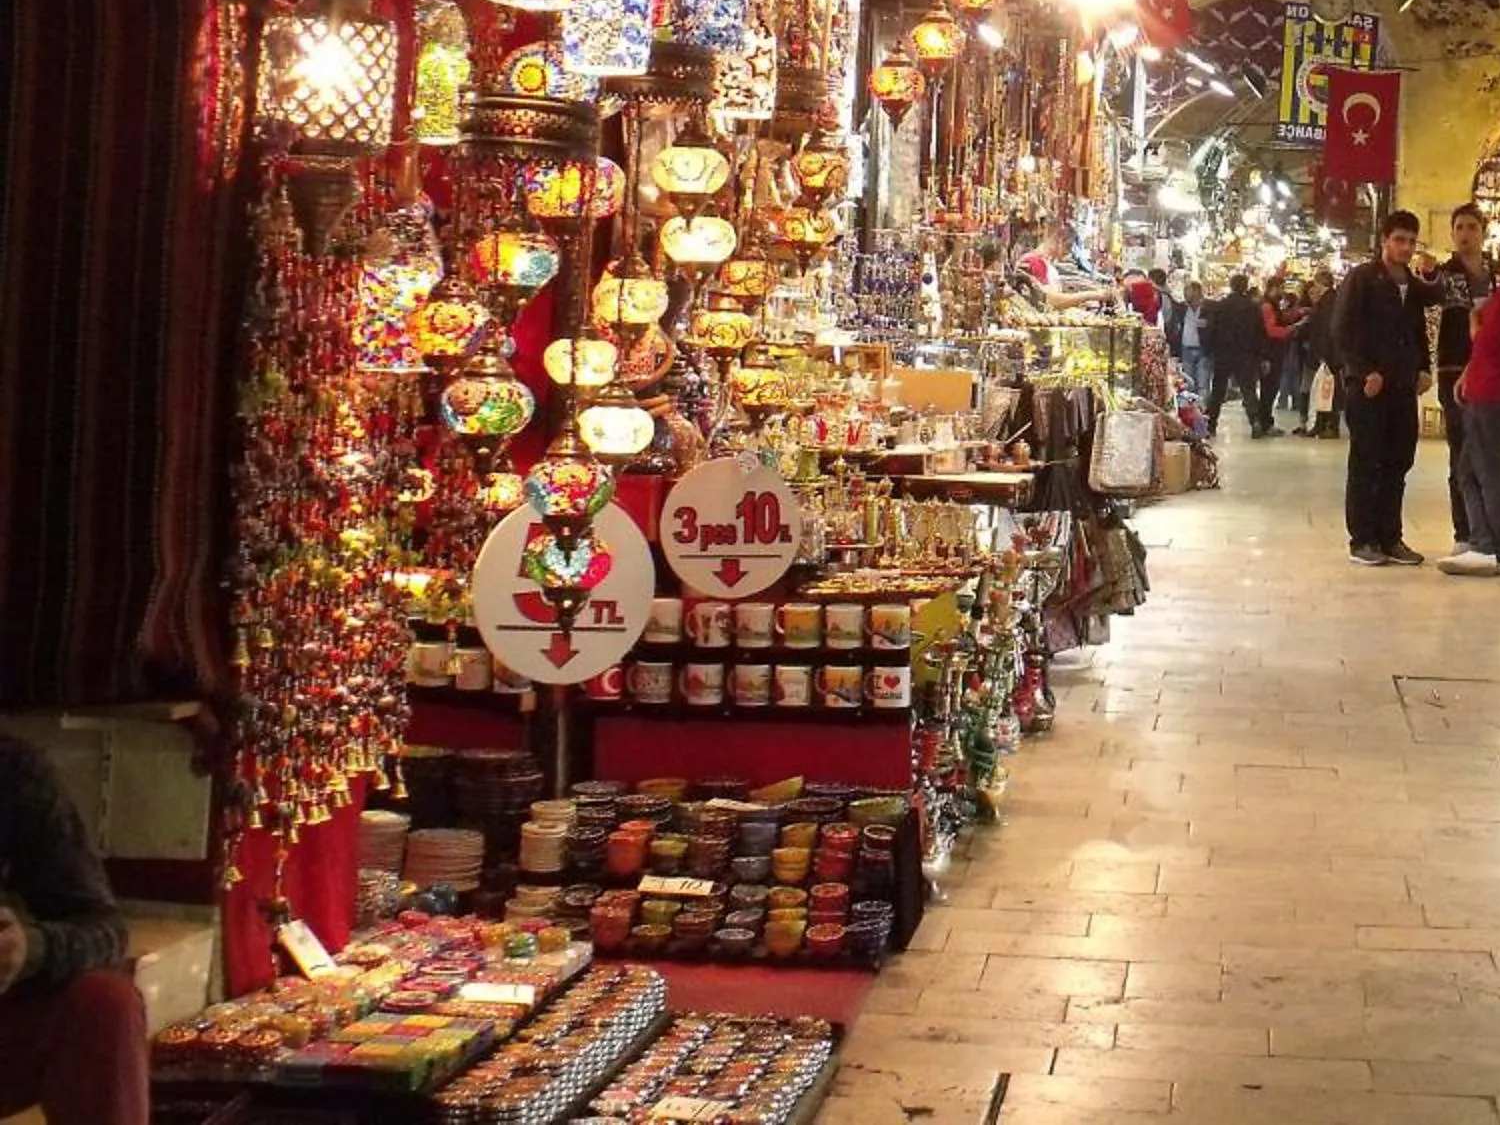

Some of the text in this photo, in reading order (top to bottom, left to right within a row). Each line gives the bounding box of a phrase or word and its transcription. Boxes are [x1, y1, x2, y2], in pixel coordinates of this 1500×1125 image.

[672, 506, 698, 544] 3
[736, 490, 781, 545] 10
[589, 600, 625, 624] TL
